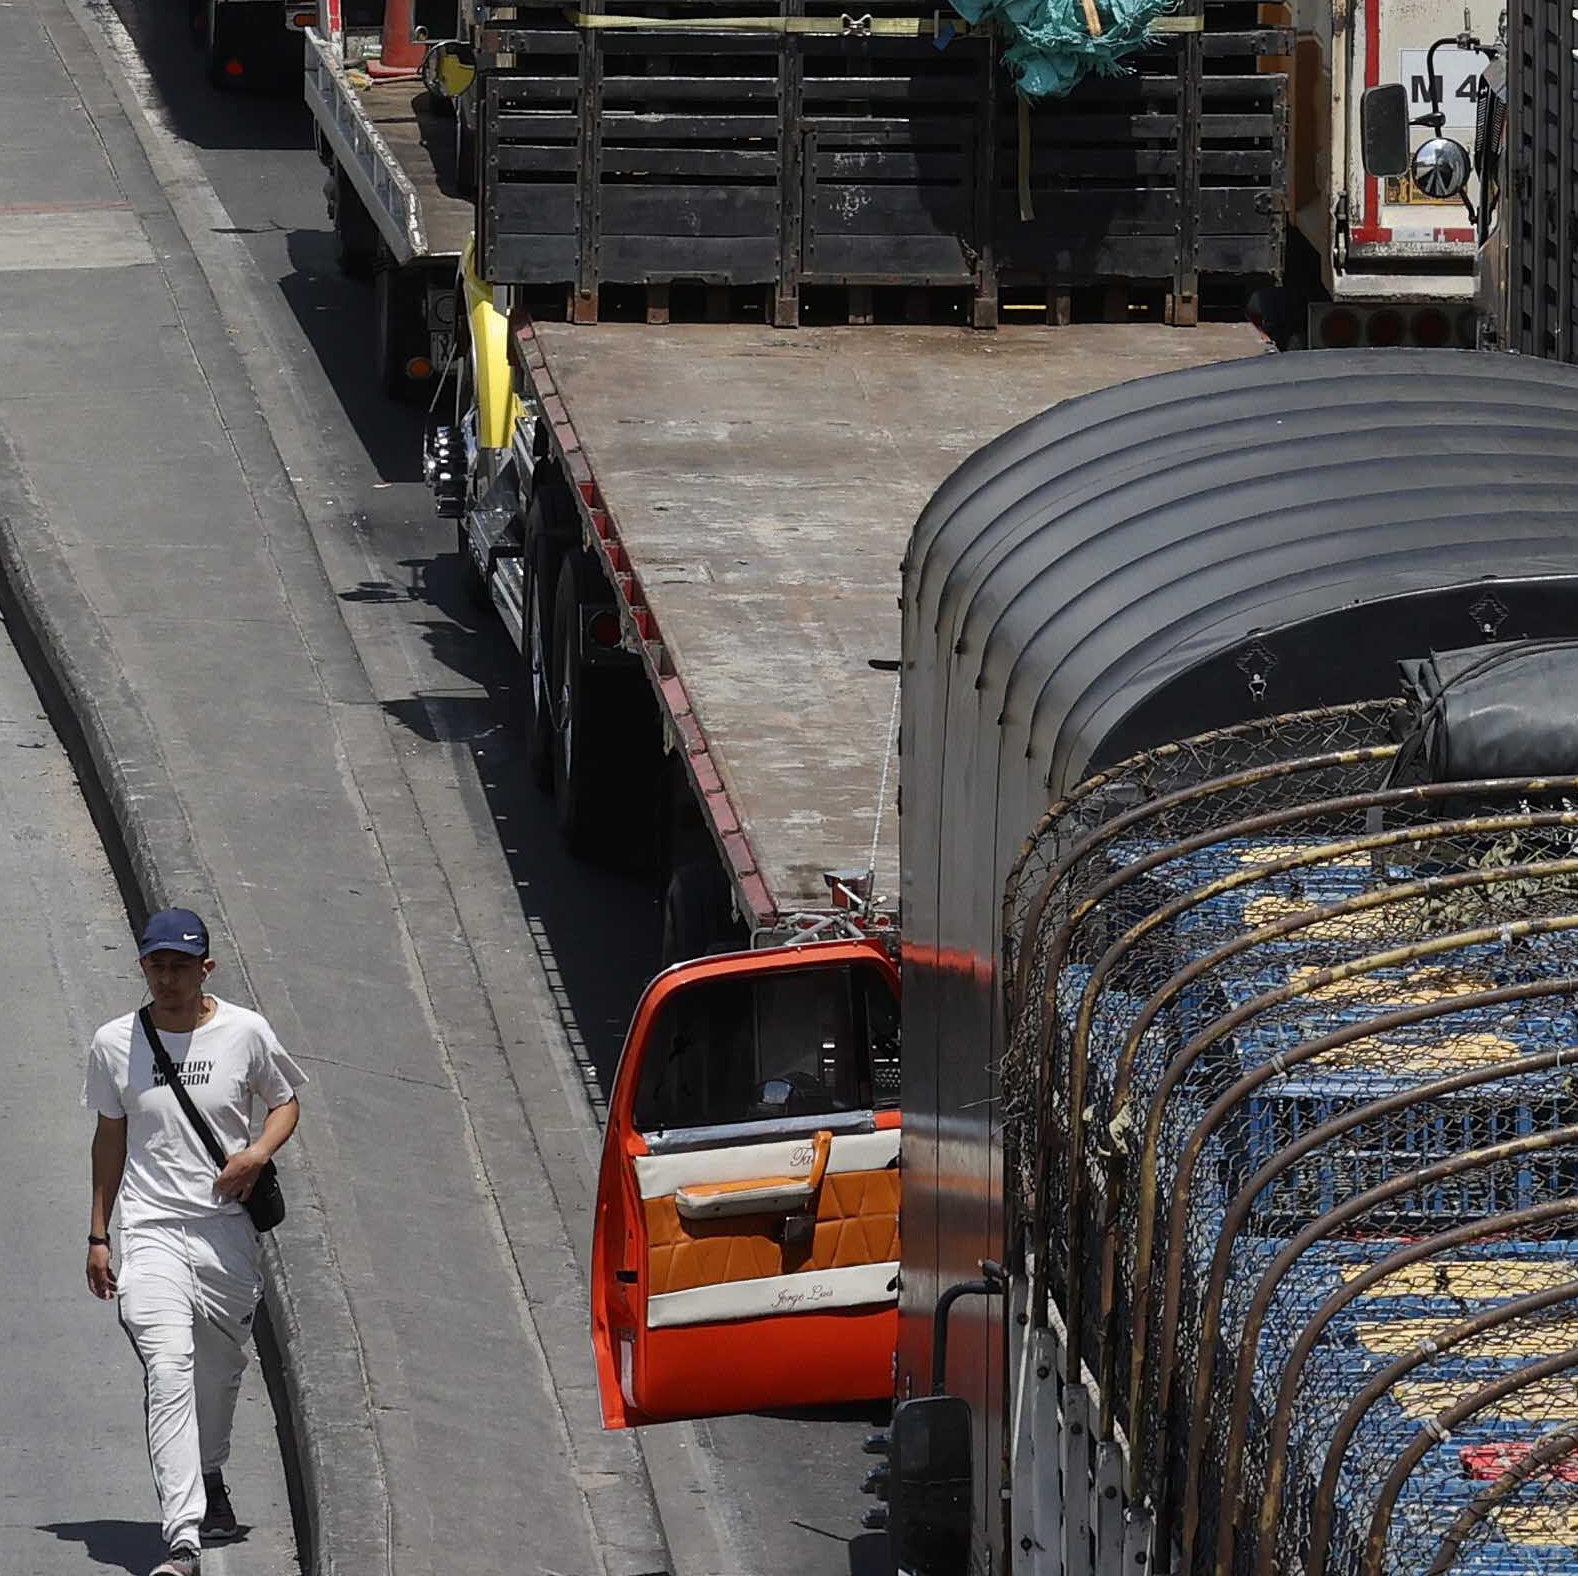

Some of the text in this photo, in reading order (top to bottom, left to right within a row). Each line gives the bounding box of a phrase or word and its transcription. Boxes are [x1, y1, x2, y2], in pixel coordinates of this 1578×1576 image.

[1411, 75, 1444, 104] M
[152, 1060, 215, 1075] MCURY
[153, 1073, 211, 1087] MSION
[771, 1283, 835, 1311] Jorge Luis
